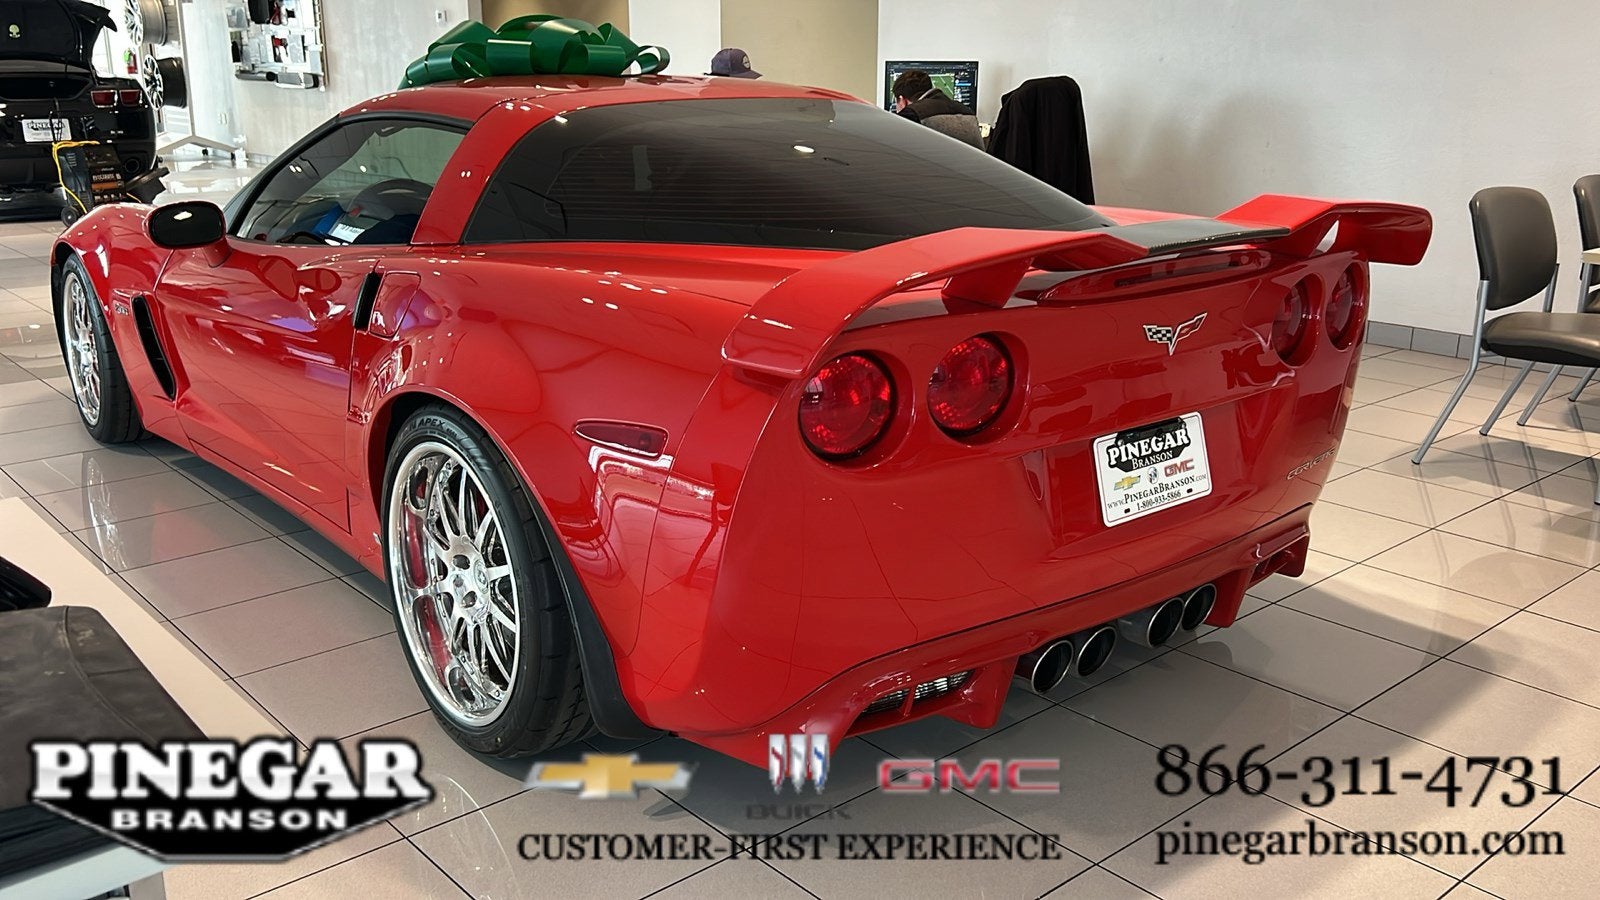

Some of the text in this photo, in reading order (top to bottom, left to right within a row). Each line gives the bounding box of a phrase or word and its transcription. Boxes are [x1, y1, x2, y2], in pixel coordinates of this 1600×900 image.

[418, 418, 445, 429] APEX
[1108, 427, 1190, 466] PINEGAR
[1132, 450, 1174, 470] BRANSON
[1164, 458, 1195, 477] GMC
